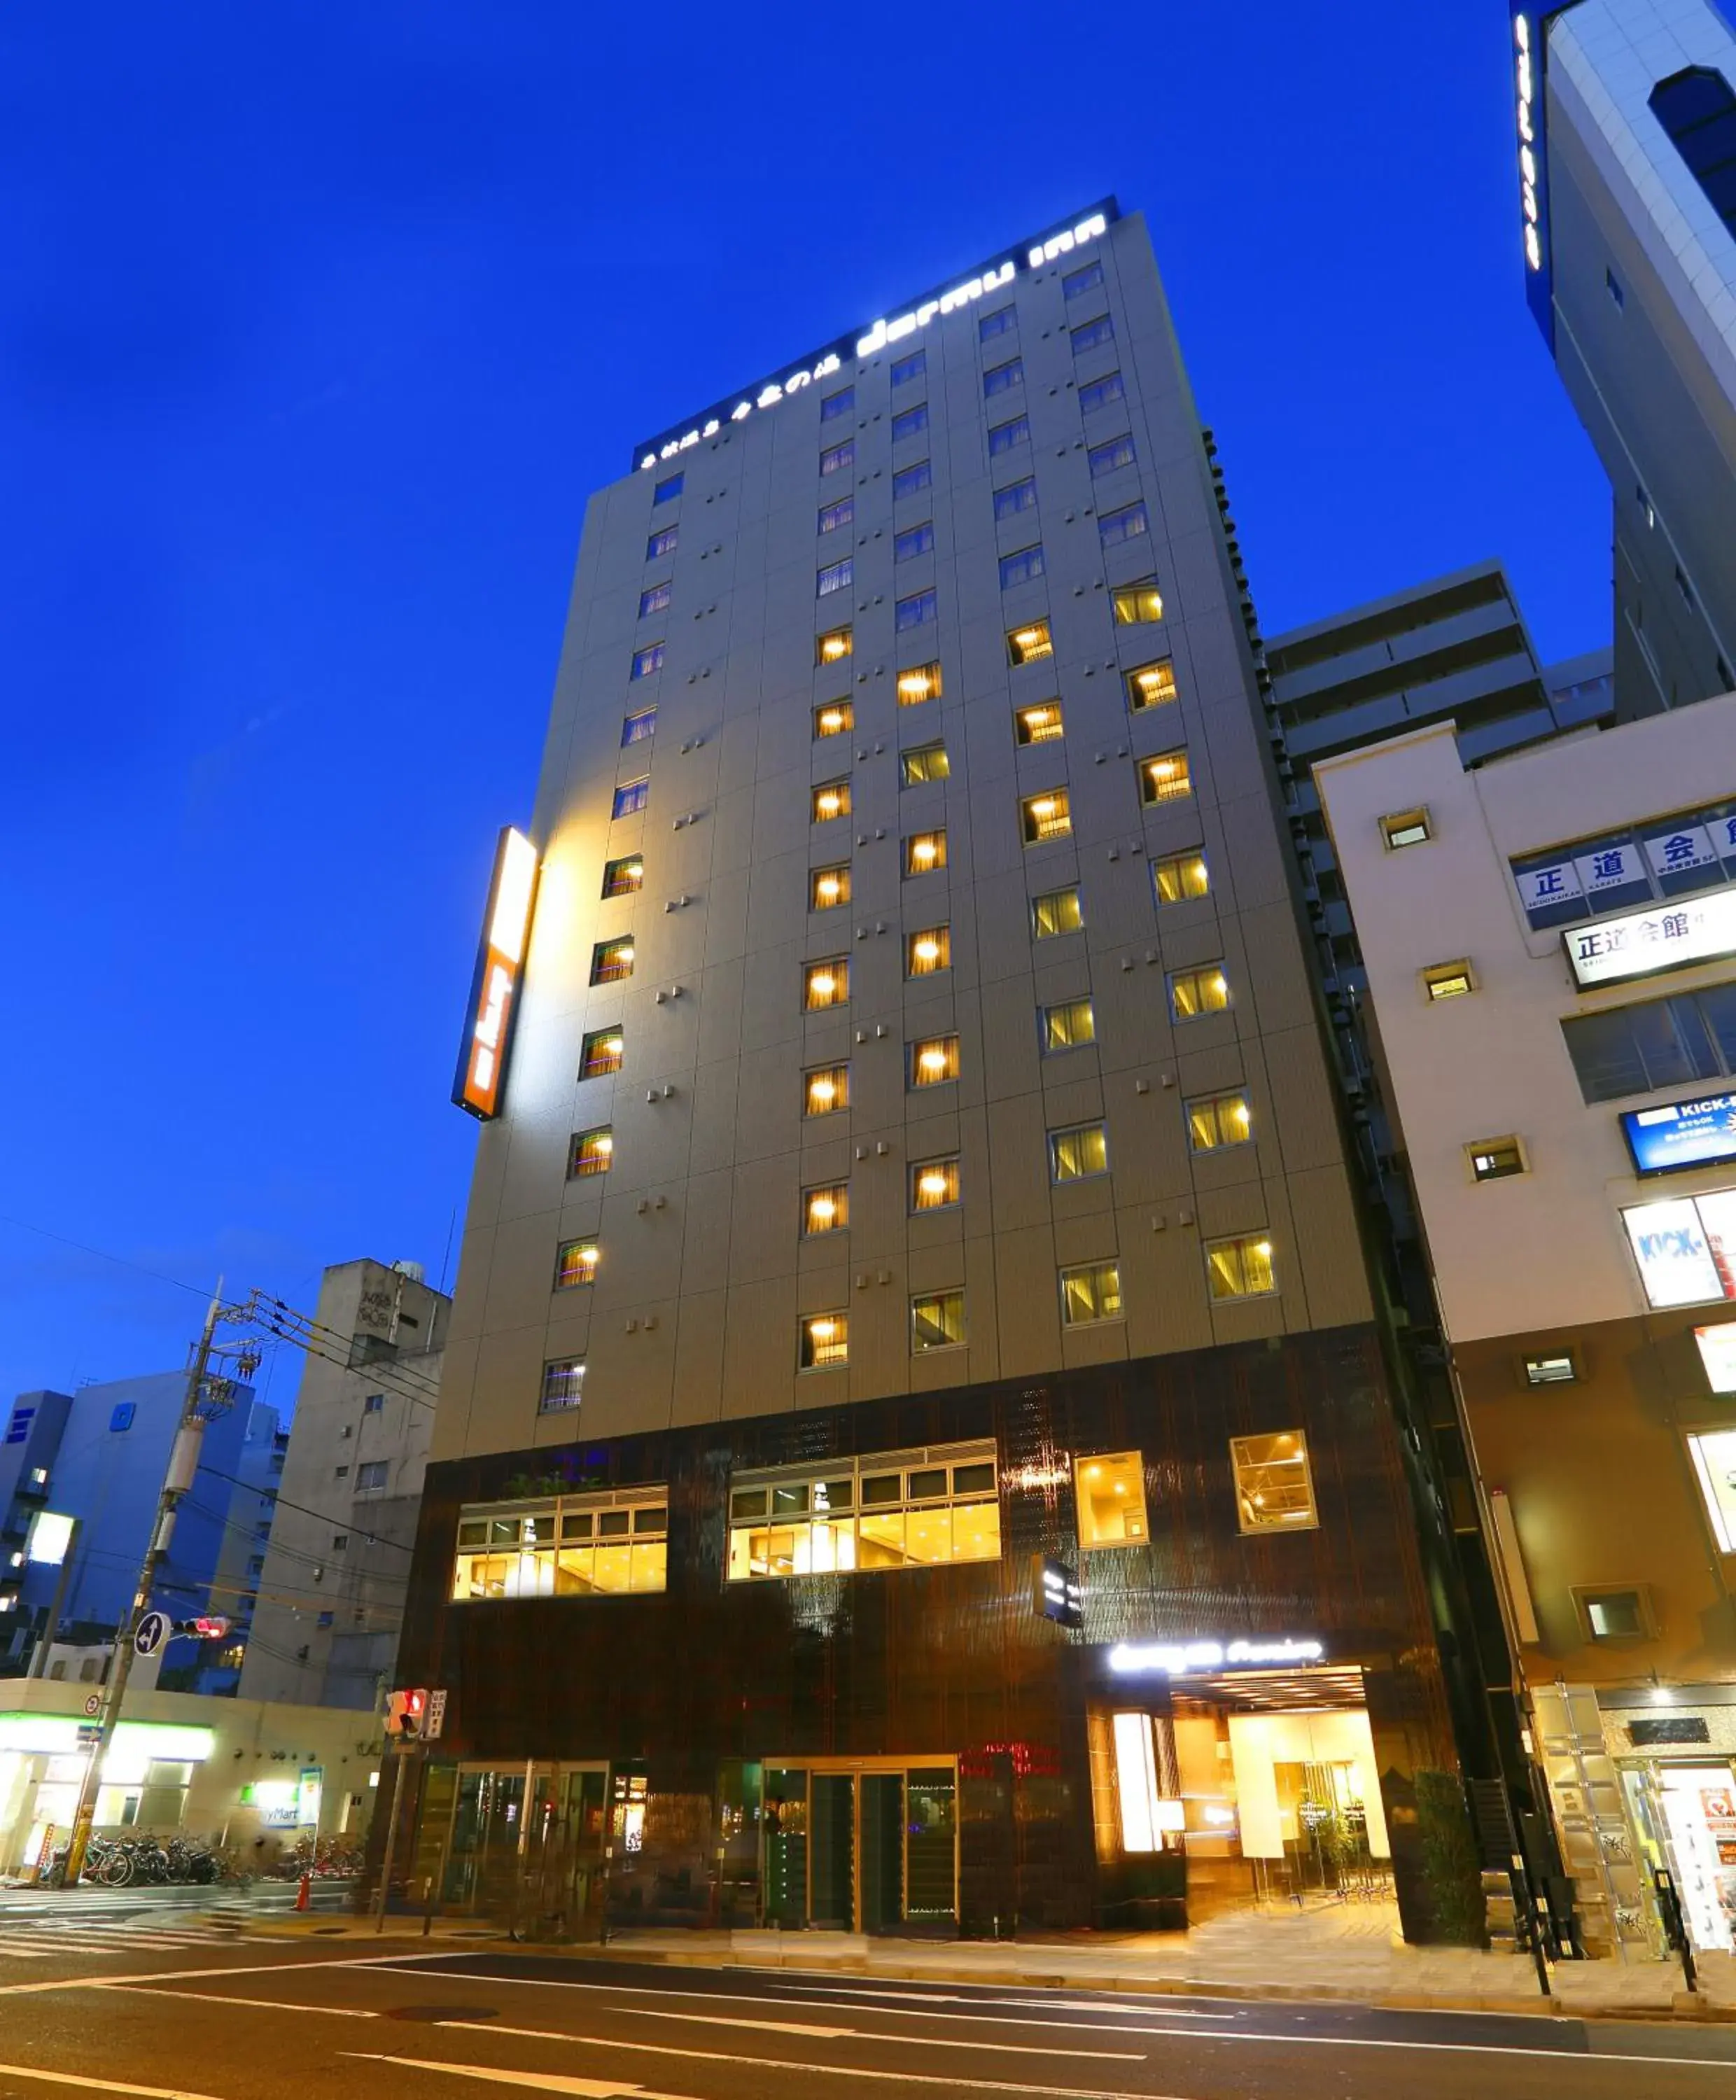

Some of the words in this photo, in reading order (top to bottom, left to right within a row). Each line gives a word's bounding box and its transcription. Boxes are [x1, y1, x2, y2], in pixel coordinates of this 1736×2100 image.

[1029, 214, 1106, 267] inn
[1576, 912, 1689, 961] 正道会館
